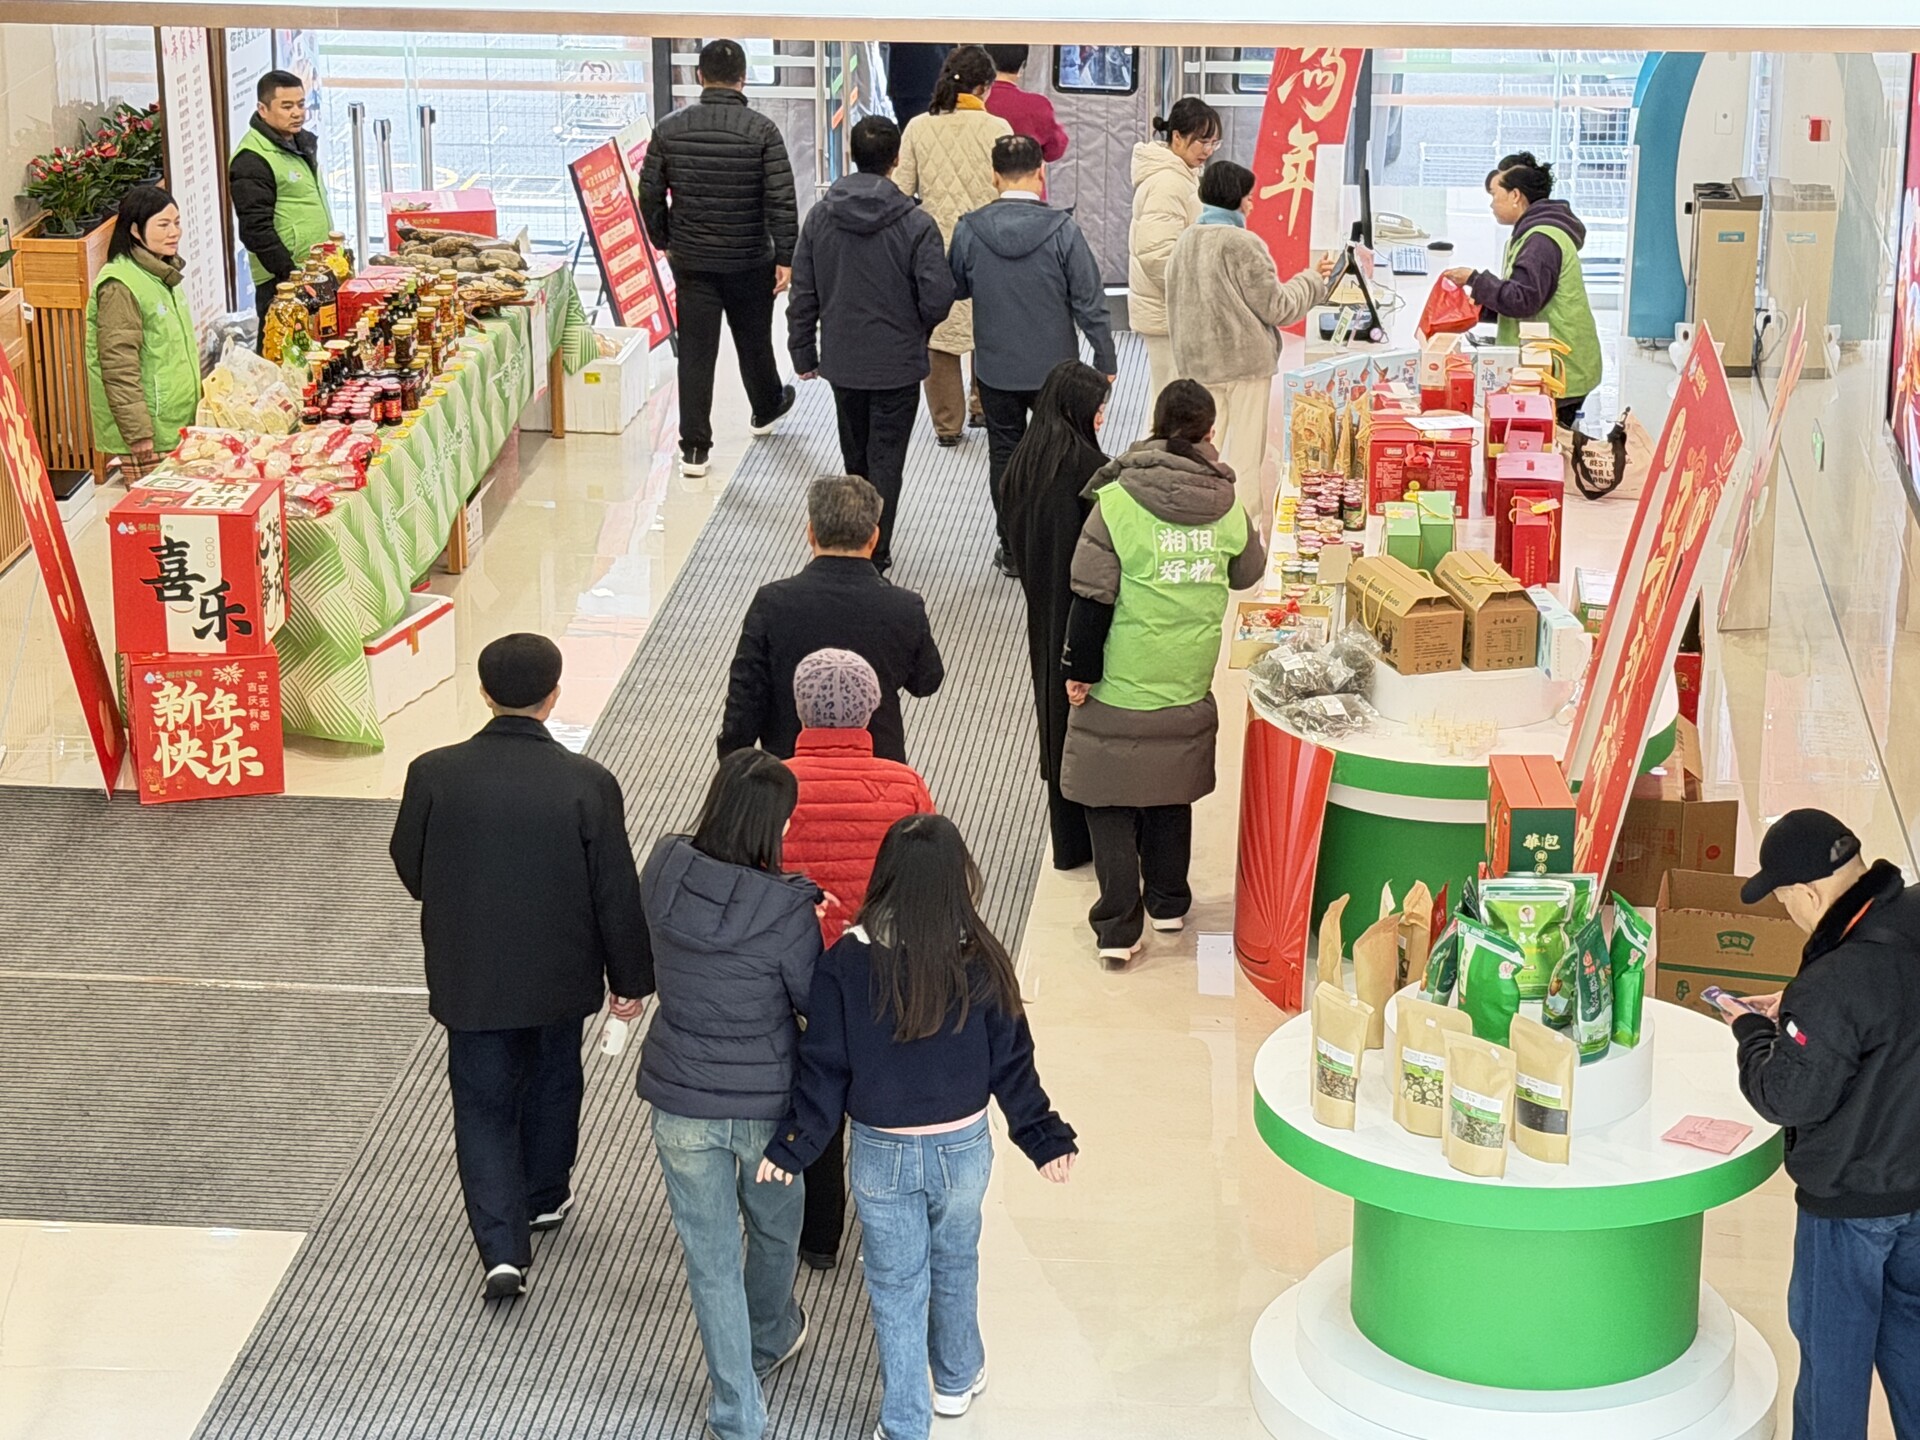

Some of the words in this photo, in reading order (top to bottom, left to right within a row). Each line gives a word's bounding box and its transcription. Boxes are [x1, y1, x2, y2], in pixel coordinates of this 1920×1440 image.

[205, 536, 216, 568] GOOD
[1158, 557, 1217, 584] 好物
[140, 535, 252, 642] 喜乐
[150, 680, 247, 732] 新年
[246, 682, 260, 732] 吉庆有余
[257, 671, 271, 722] 平安无恙
[153, 723, 265, 787] 快乐
